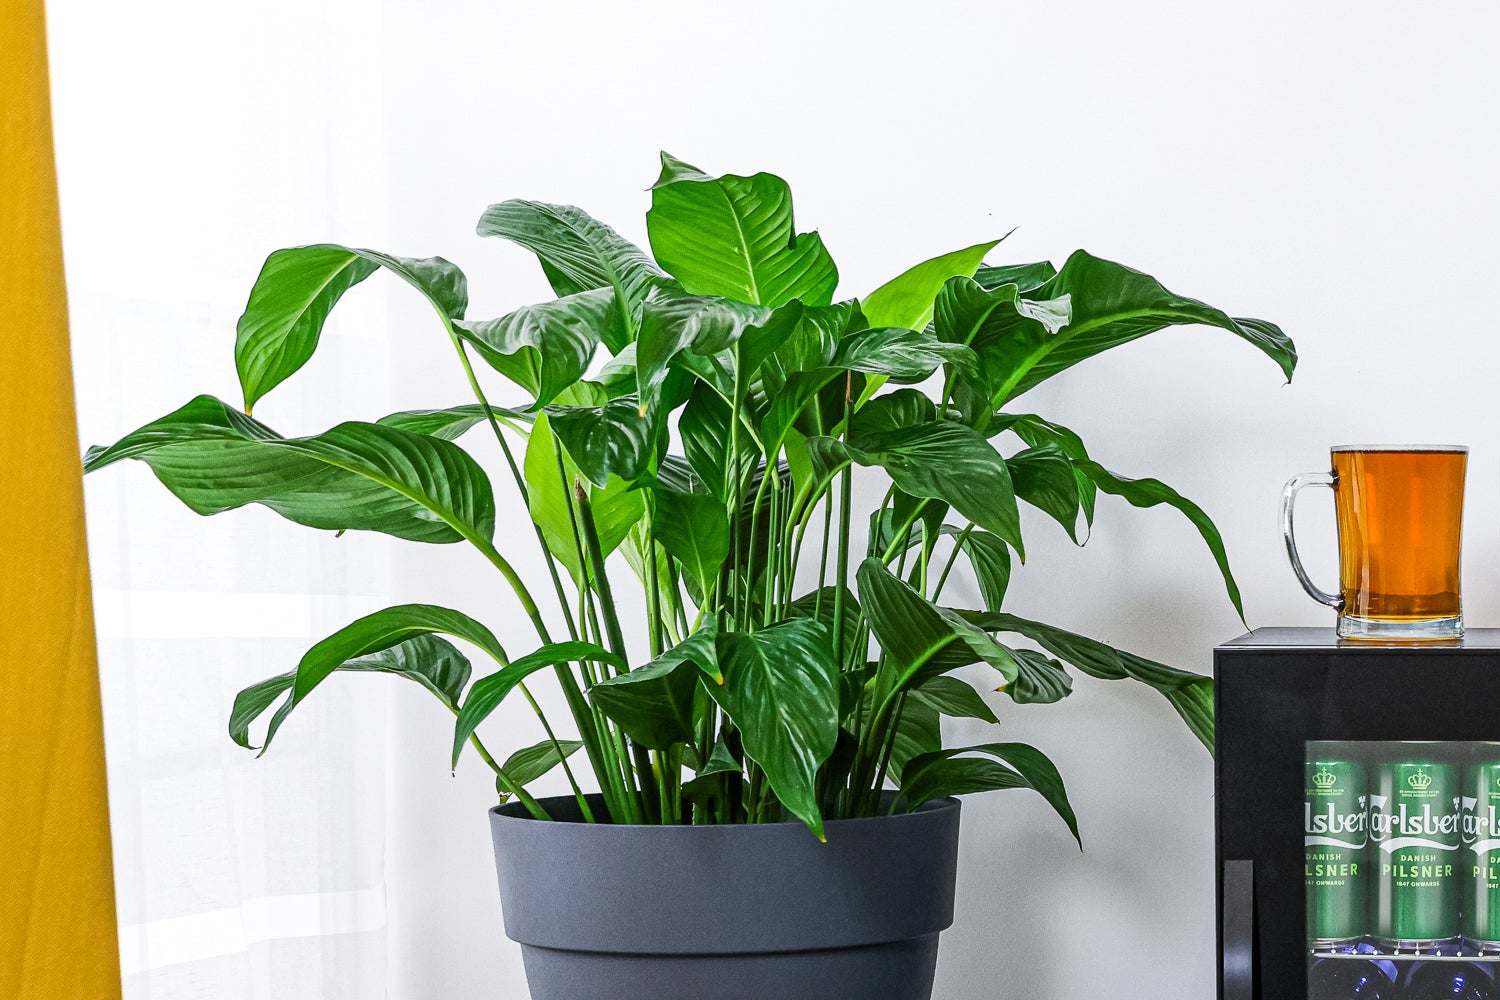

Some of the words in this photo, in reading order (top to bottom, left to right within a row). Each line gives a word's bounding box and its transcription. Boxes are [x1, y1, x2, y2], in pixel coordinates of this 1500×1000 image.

[1369, 794, 1460, 854] Carlsber
[1305, 853, 1342, 861] DANISH
[1400, 854, 1436, 862] DANISH
[1304, 863, 1358, 877] LSNER
[1382, 864, 1452, 878] PILSNER
